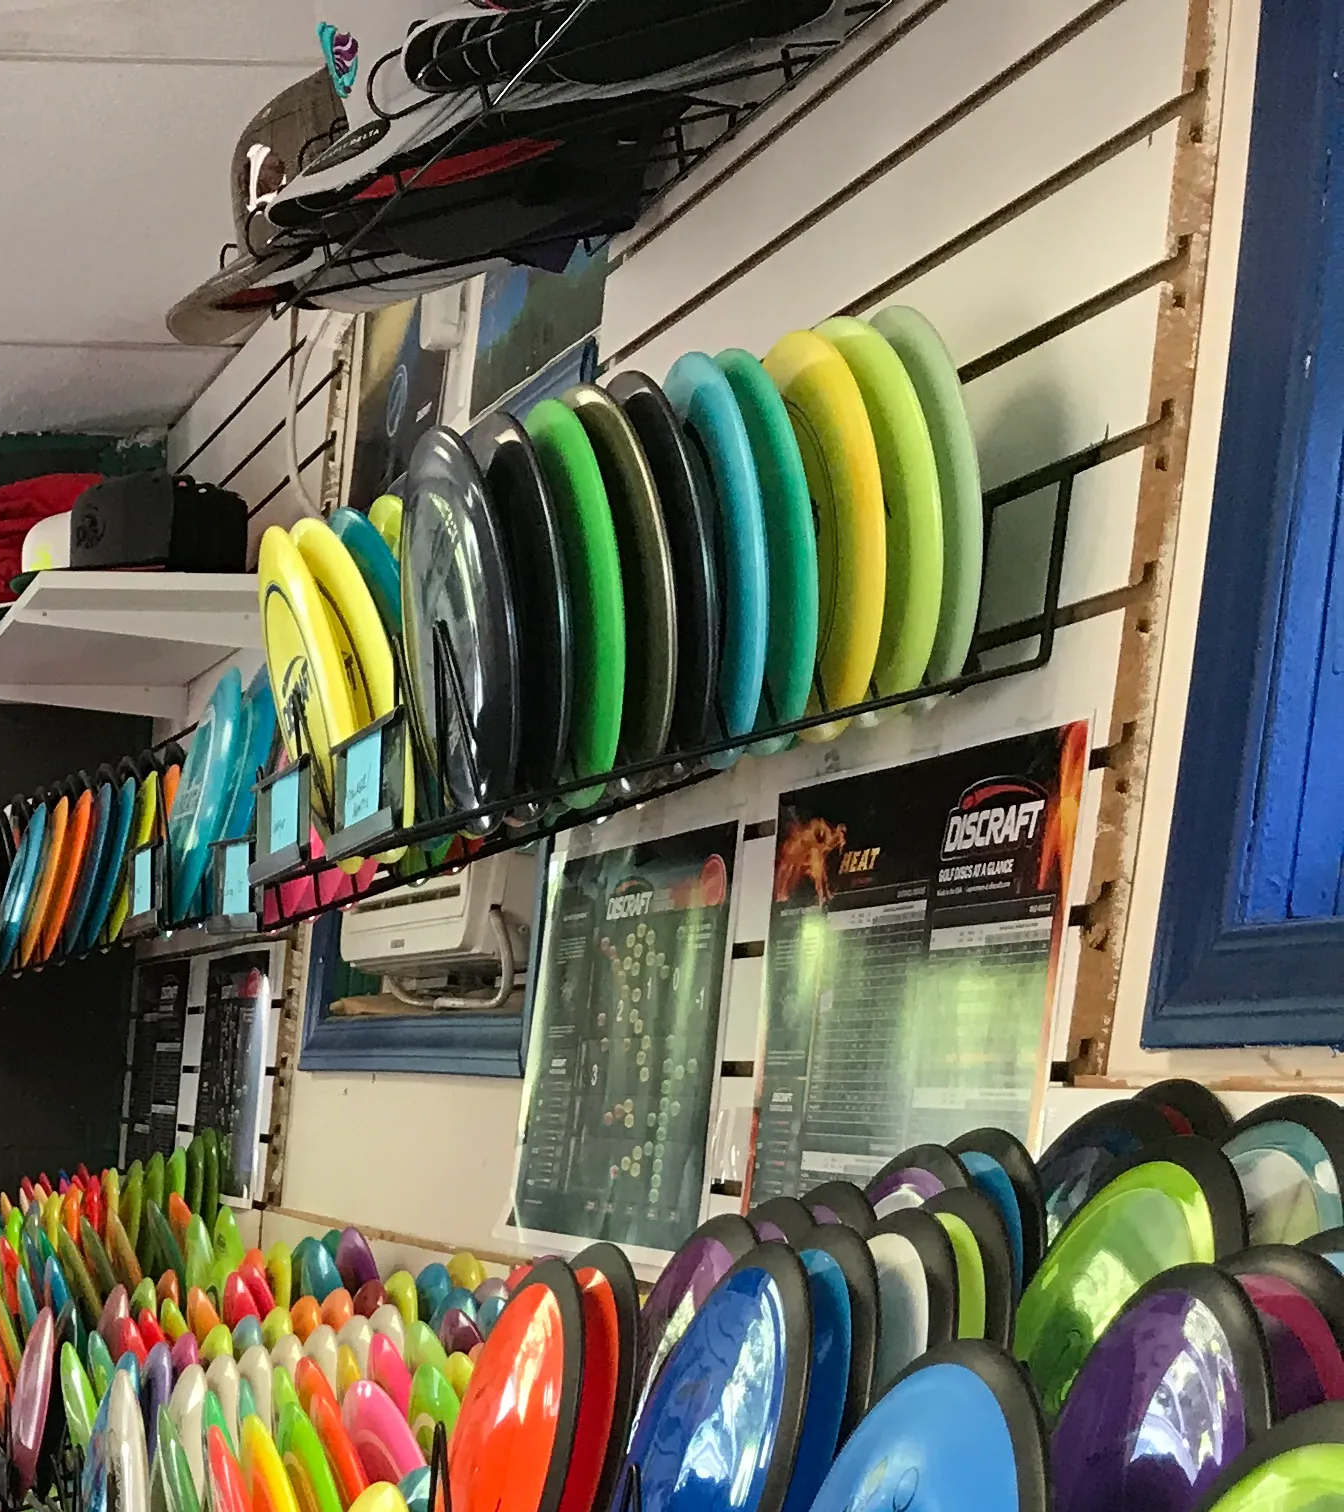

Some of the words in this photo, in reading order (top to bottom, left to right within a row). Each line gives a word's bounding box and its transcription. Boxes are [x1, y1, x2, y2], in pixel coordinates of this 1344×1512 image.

[944, 800, 1046, 852] DISCRAFT
[839, 847, 880, 874] HEAT
[954, 864, 973, 880] DISCS
[987, 859, 1014, 876] GLANCE
[606, 891, 653, 920] DISCRAFT
[616, 1000, 625, 1022] 2
[591, 1064, 599, 1086] 3
